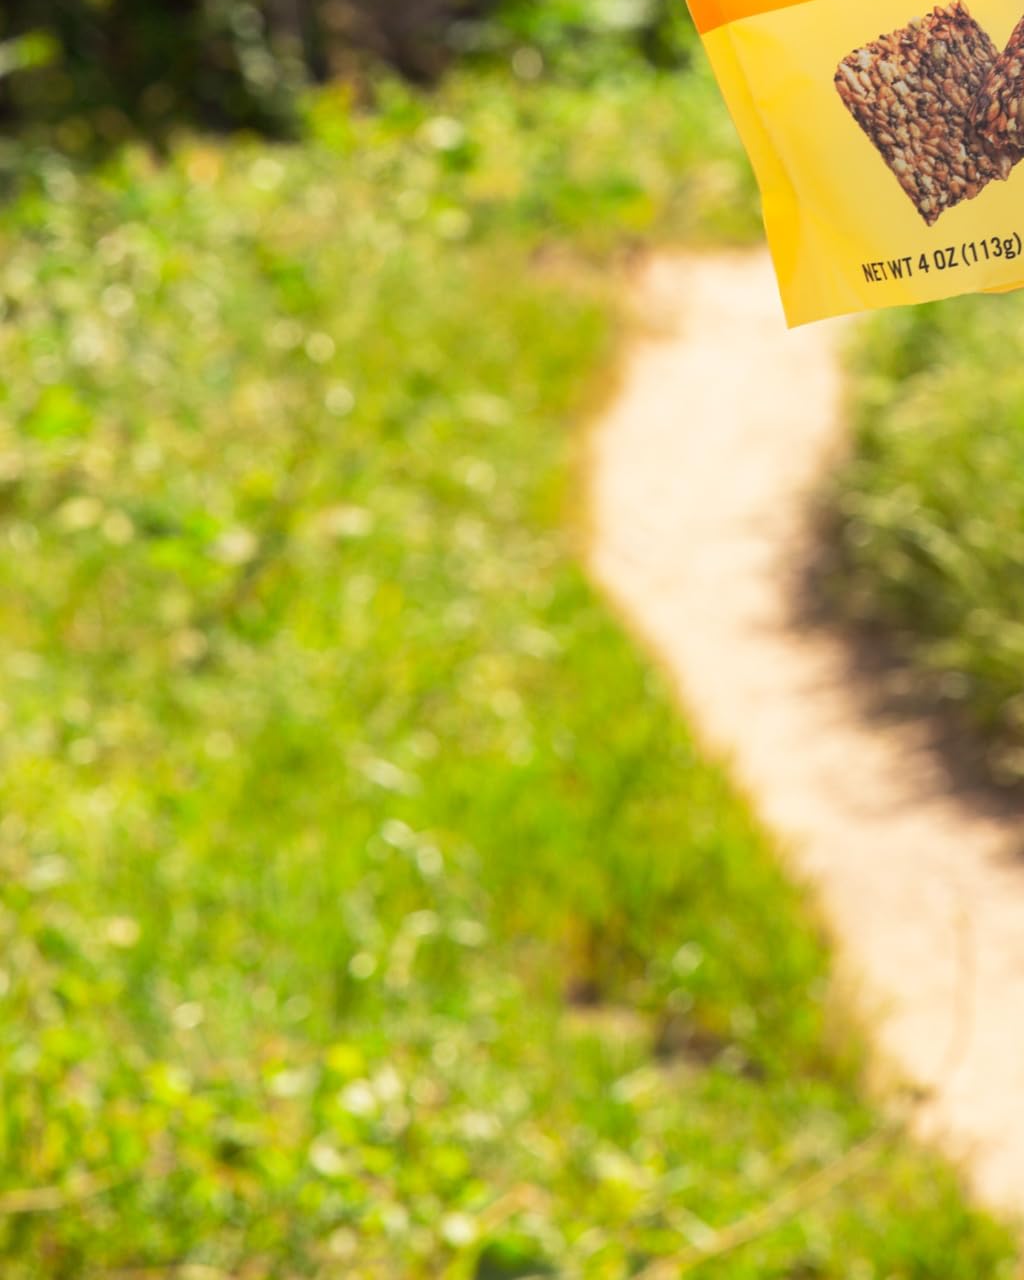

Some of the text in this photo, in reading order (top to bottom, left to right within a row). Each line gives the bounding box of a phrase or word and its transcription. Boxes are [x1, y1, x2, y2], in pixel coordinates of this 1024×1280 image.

[861, 231, 1023, 283] NET WT 4 OZ (113g)
